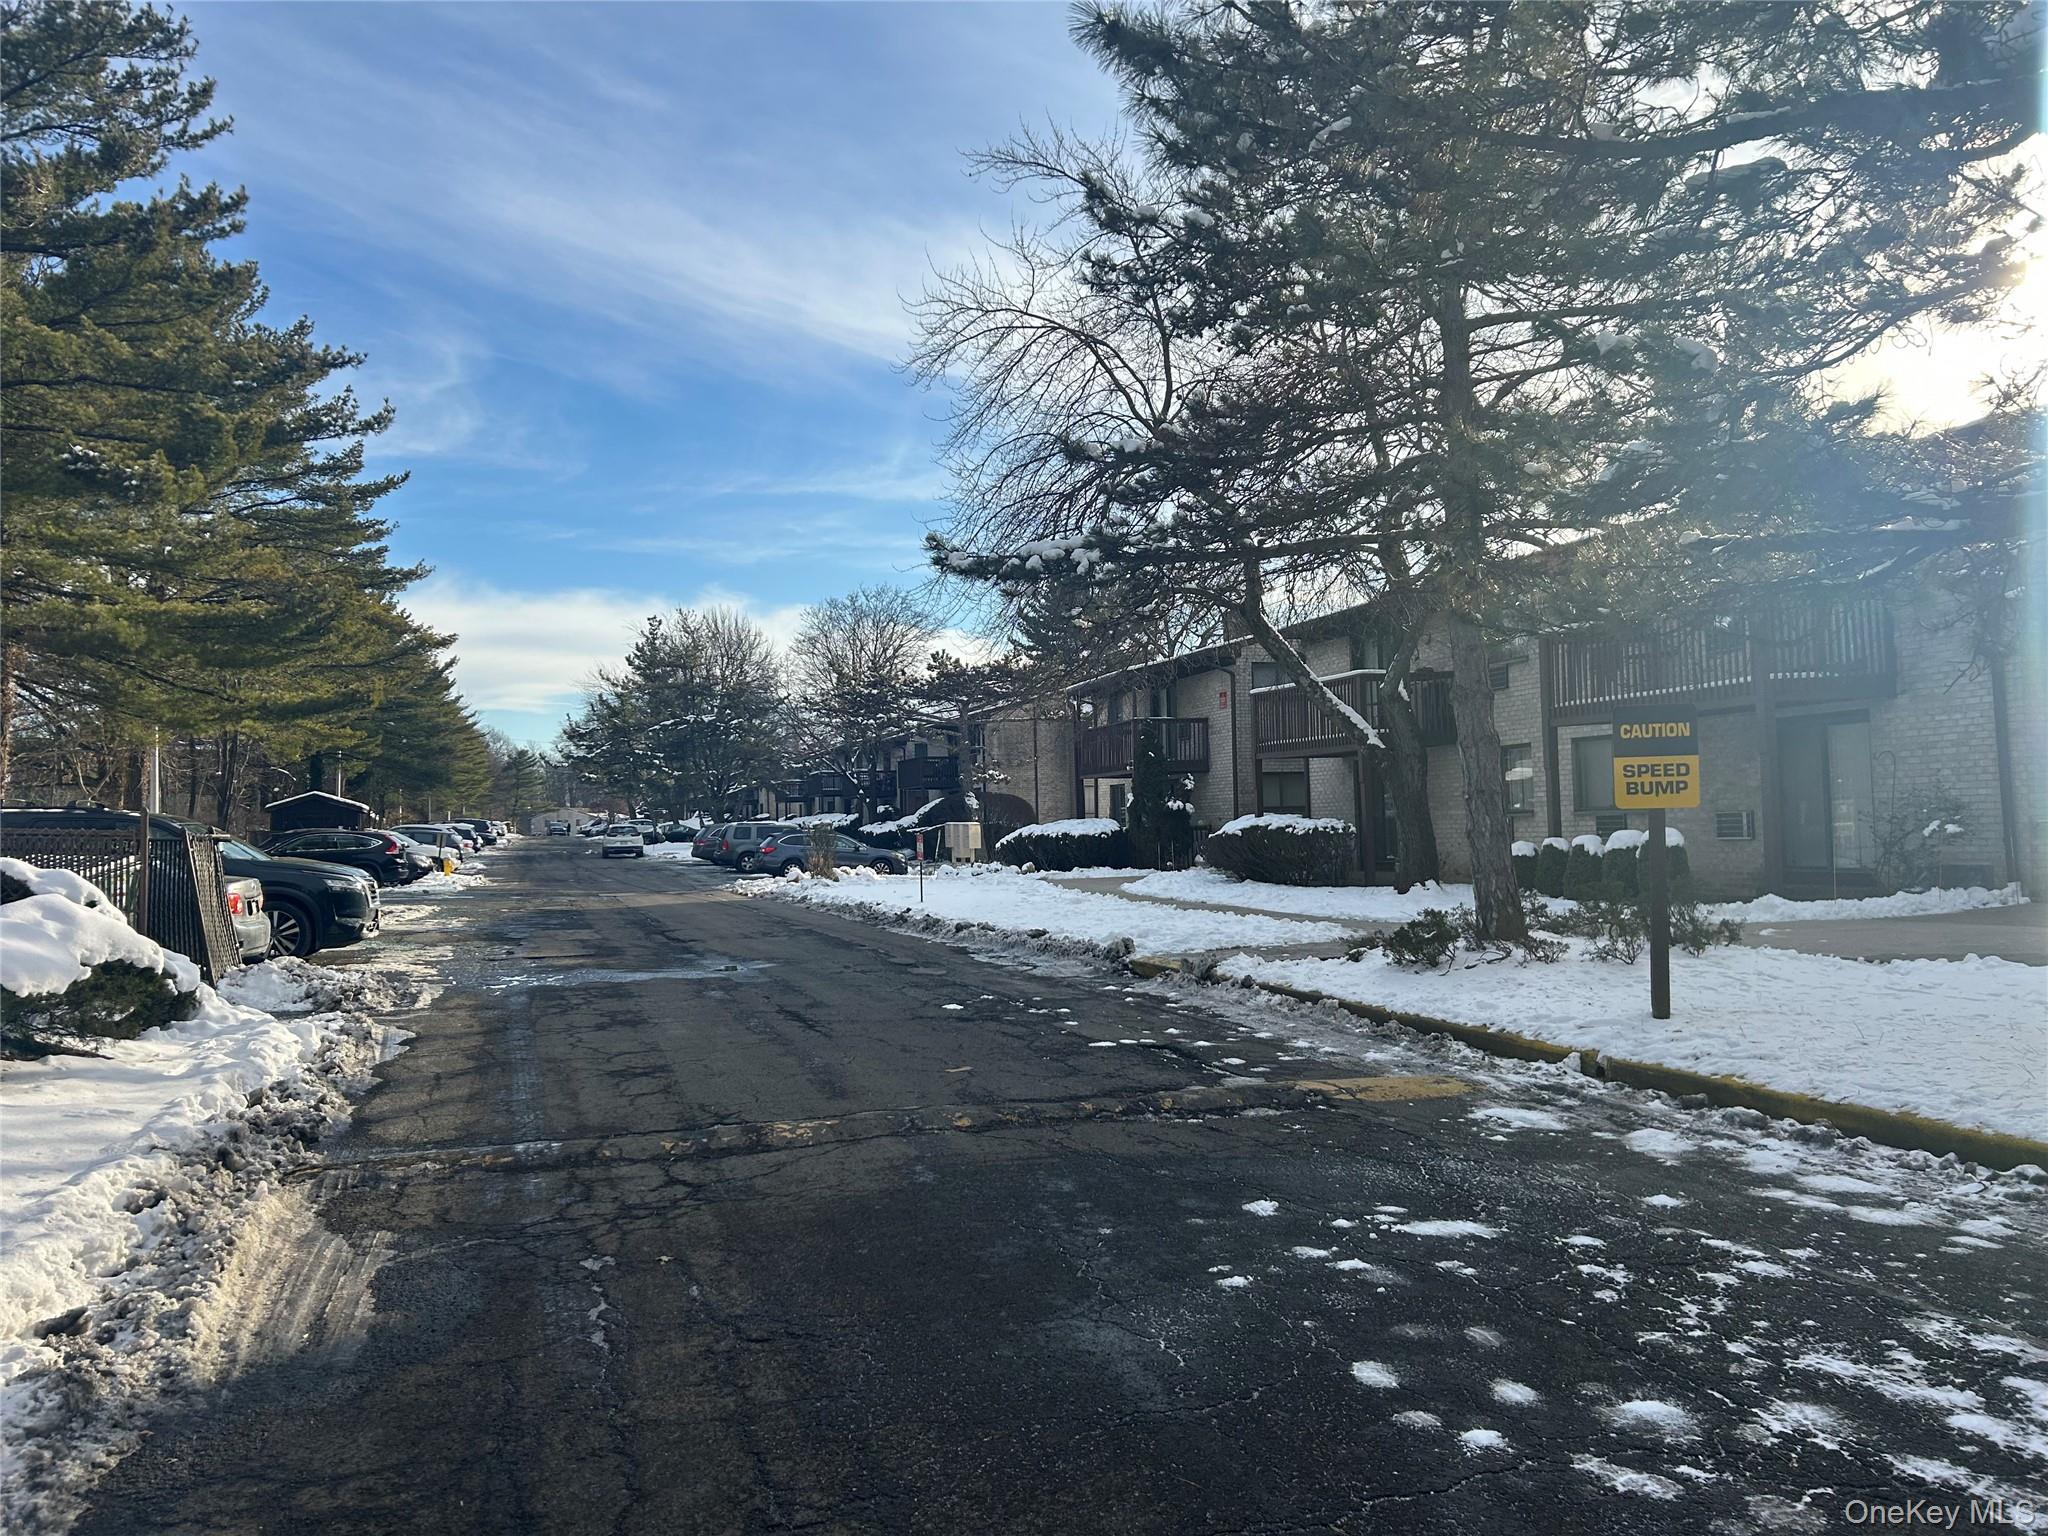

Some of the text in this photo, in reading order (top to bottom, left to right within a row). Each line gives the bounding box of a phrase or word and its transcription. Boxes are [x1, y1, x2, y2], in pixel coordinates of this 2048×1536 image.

[1620, 722, 1690, 738] CAUTION
[1623, 764, 1690, 778] SPEED
[1626, 781, 1688, 796] BUMP
